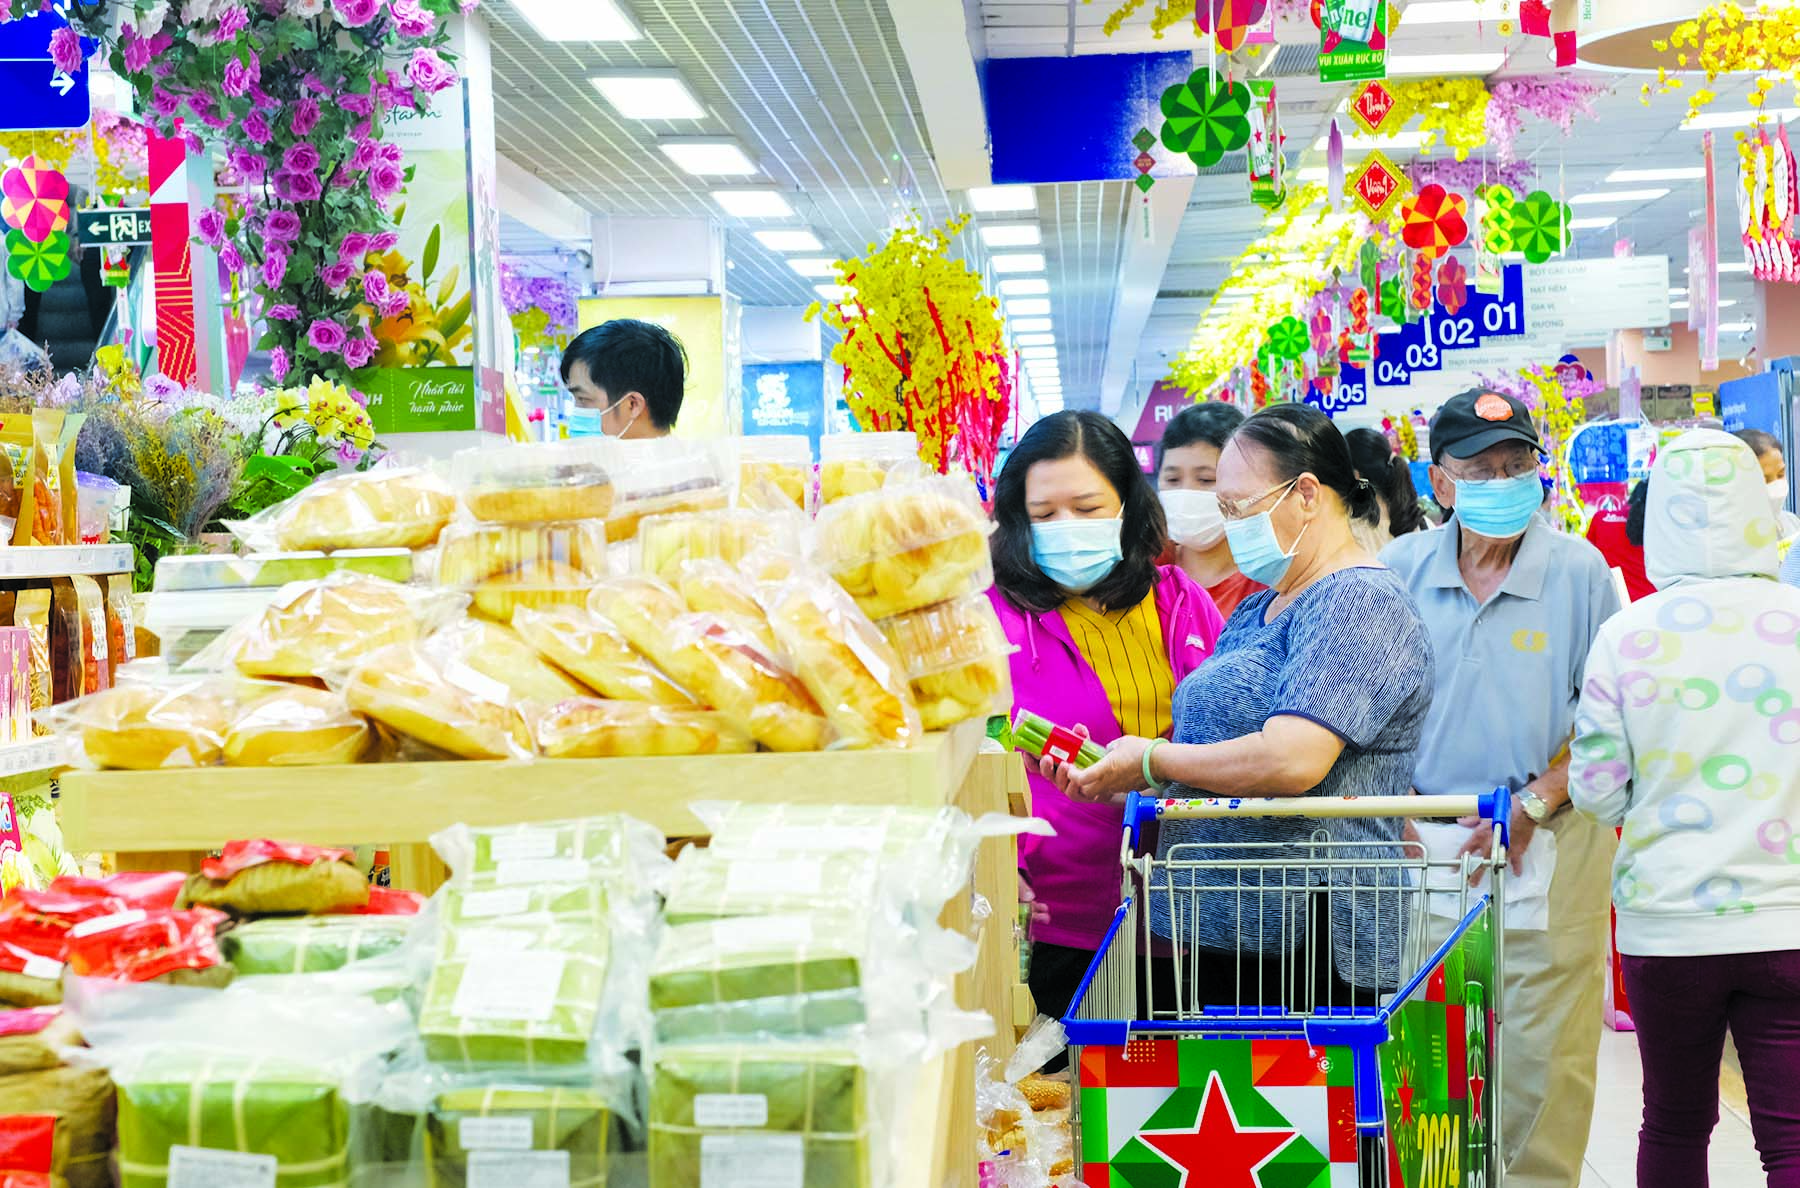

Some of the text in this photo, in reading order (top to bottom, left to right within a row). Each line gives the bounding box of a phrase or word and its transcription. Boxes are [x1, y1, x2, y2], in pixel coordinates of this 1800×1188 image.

[1319, 55, 1332, 66] VUI
[384, 104, 442, 125] sfarm
[138, 220, 151, 233] EX
[1483, 302, 1517, 331] 01
[1439, 318, 1475, 345] 02
[1406, 343, 1438, 368] 03
[1378, 361, 1408, 382] 04
[367, 393, 383, 406] NH
[1338, 383, 1364, 402] 05
[1417, 1113, 1461, 1188] 2024
